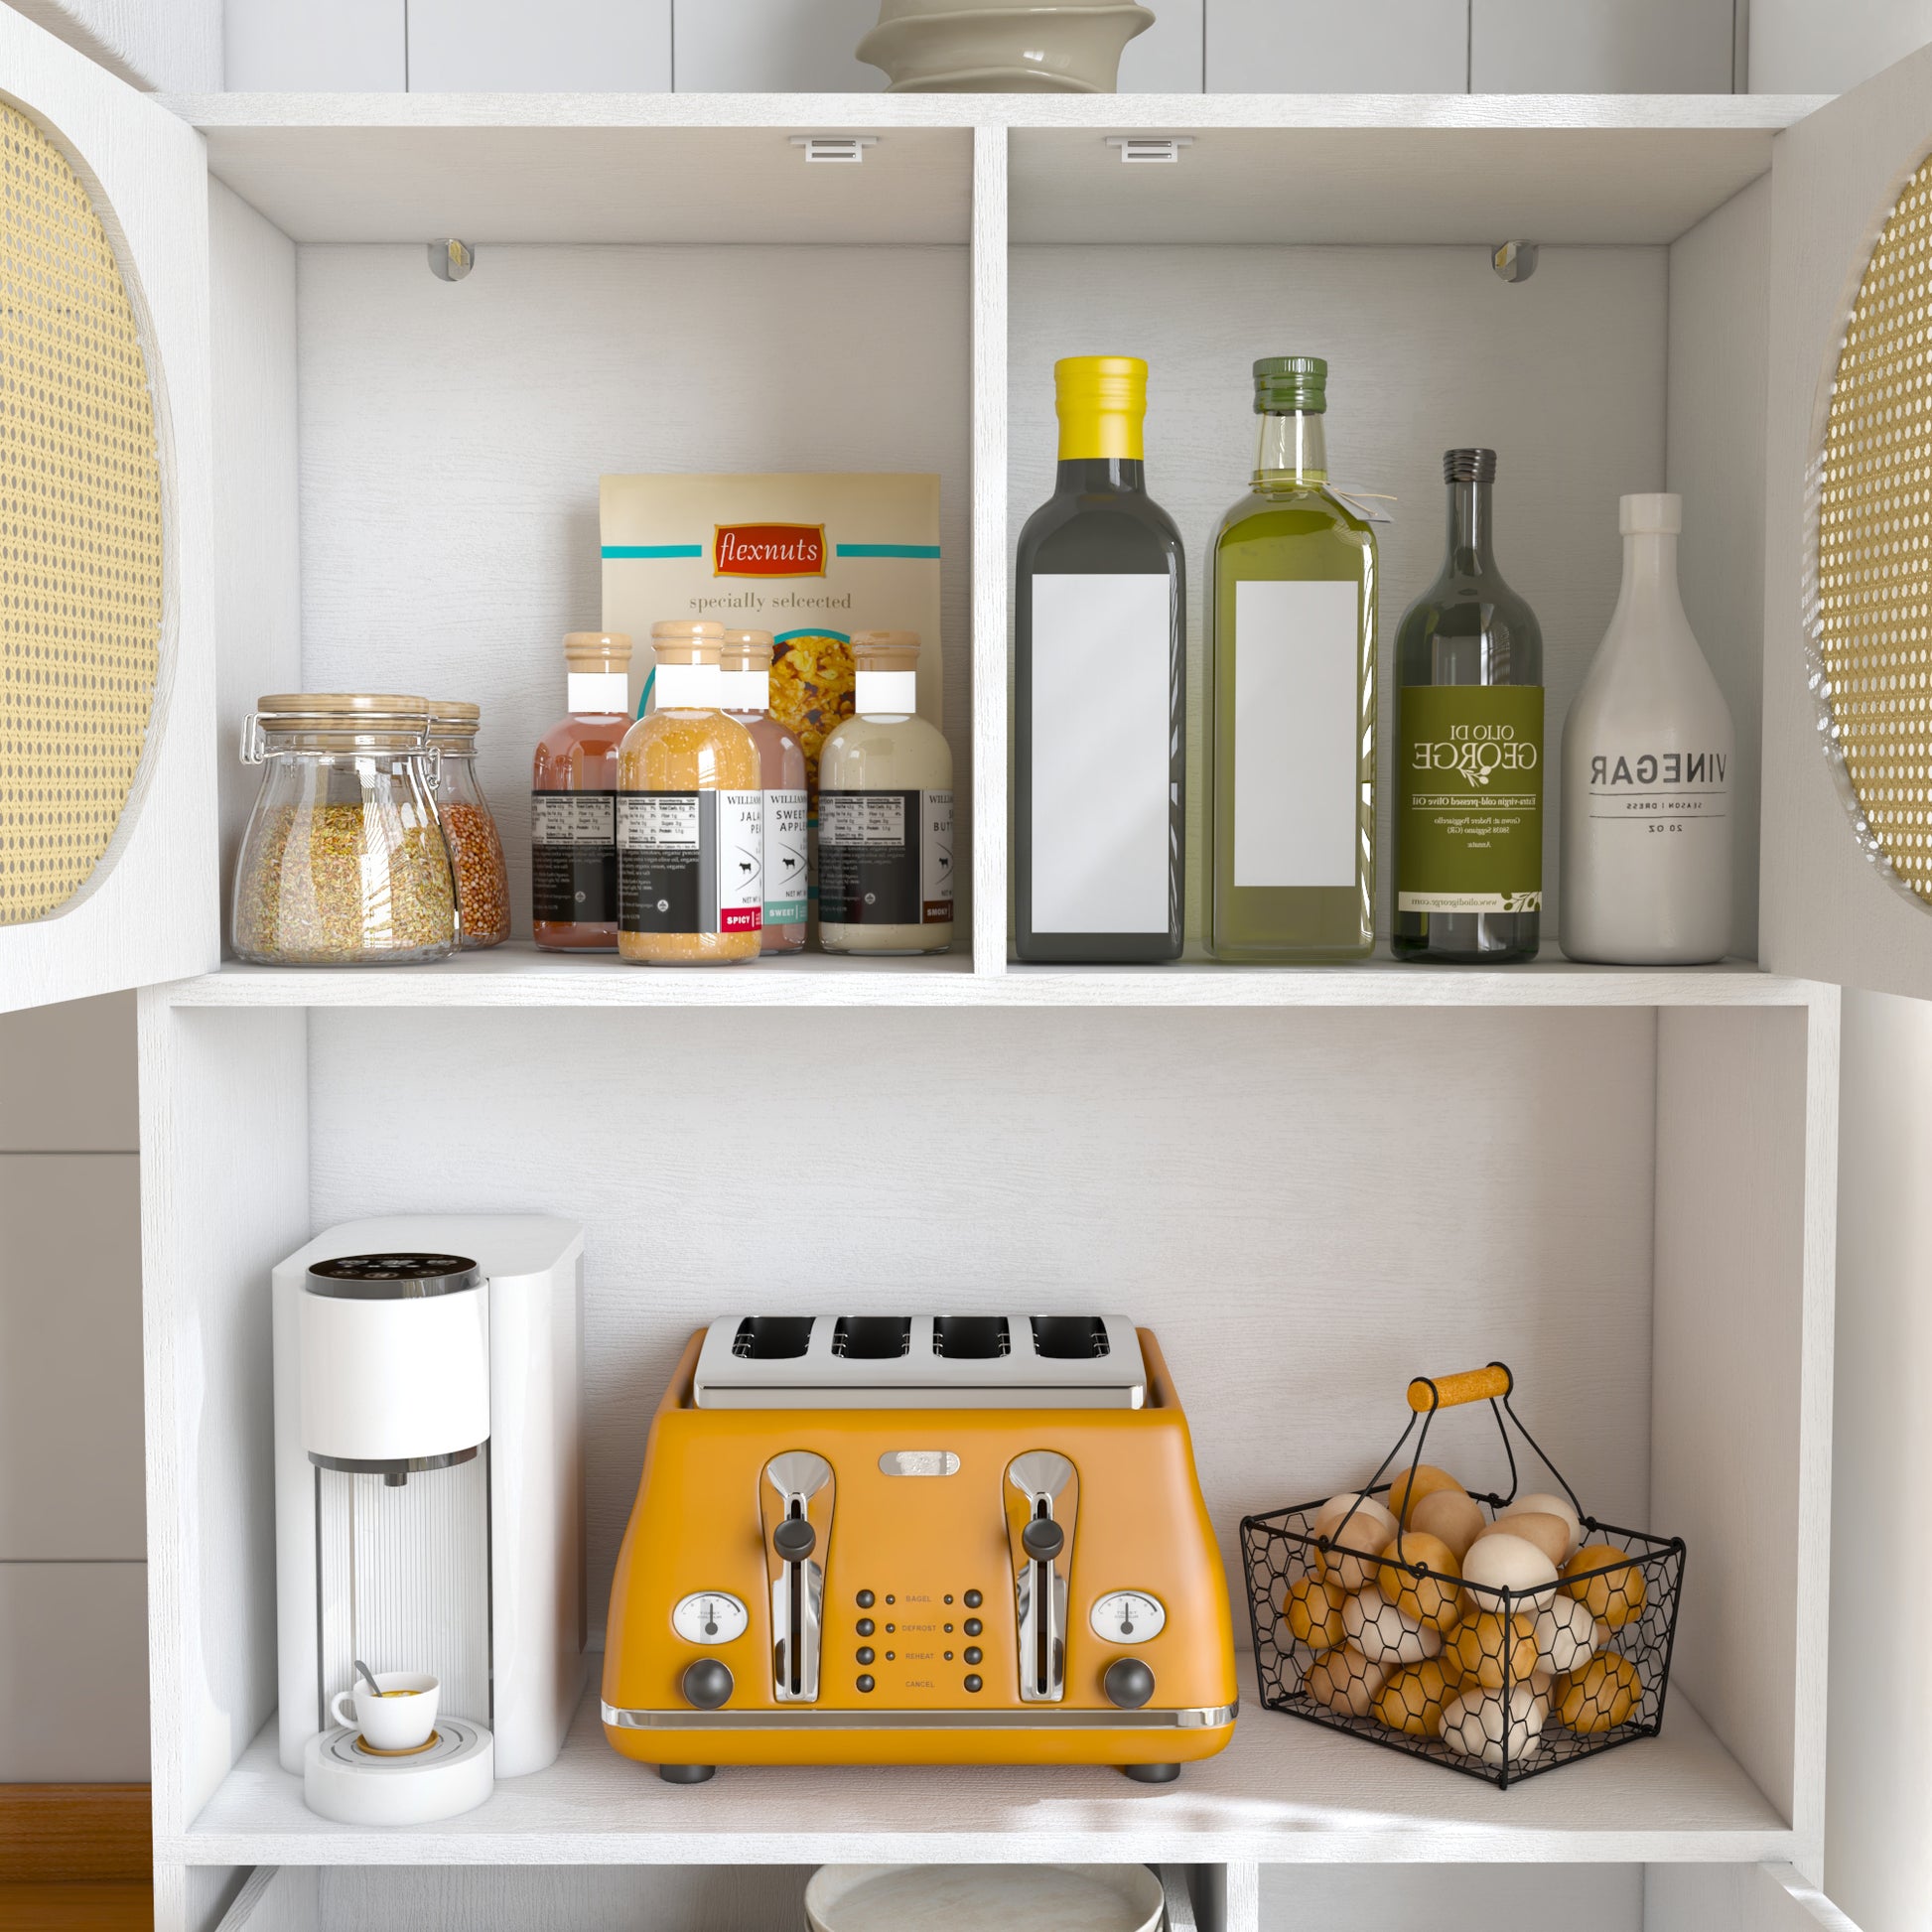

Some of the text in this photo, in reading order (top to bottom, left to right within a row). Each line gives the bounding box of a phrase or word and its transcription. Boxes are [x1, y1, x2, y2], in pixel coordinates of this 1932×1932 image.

[719, 532, 818, 568] flexnuts
[689, 592, 765, 614] specially
[726, 914, 751, 925] SPICY
